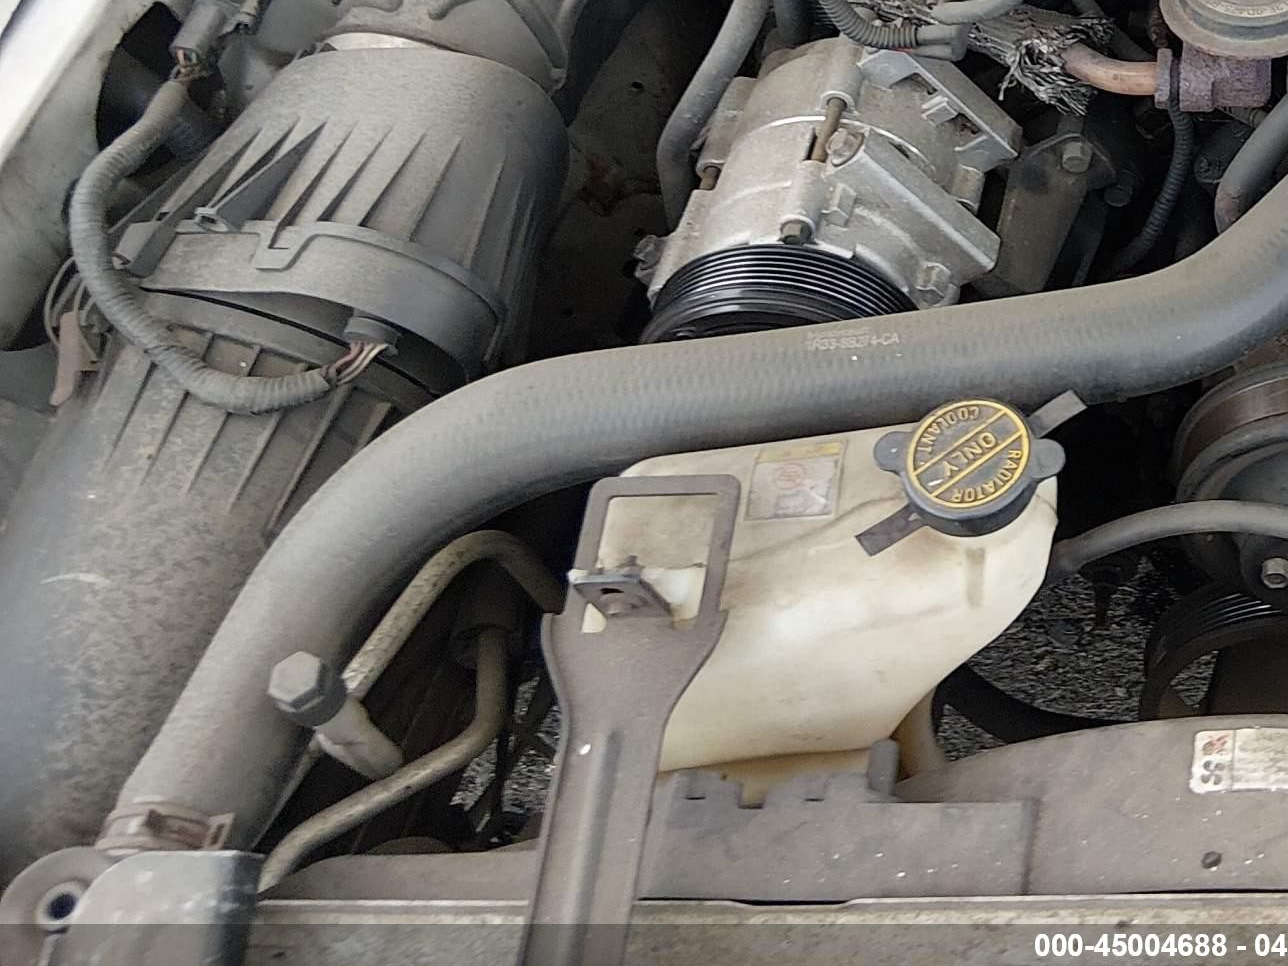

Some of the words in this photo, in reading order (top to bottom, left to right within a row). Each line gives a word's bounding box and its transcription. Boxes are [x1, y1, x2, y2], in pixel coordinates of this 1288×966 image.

[916, 405, 980, 455] COOLANT
[942, 431, 998, 478] ONLY
[951, 449, 1023, 502] RADIATOR
